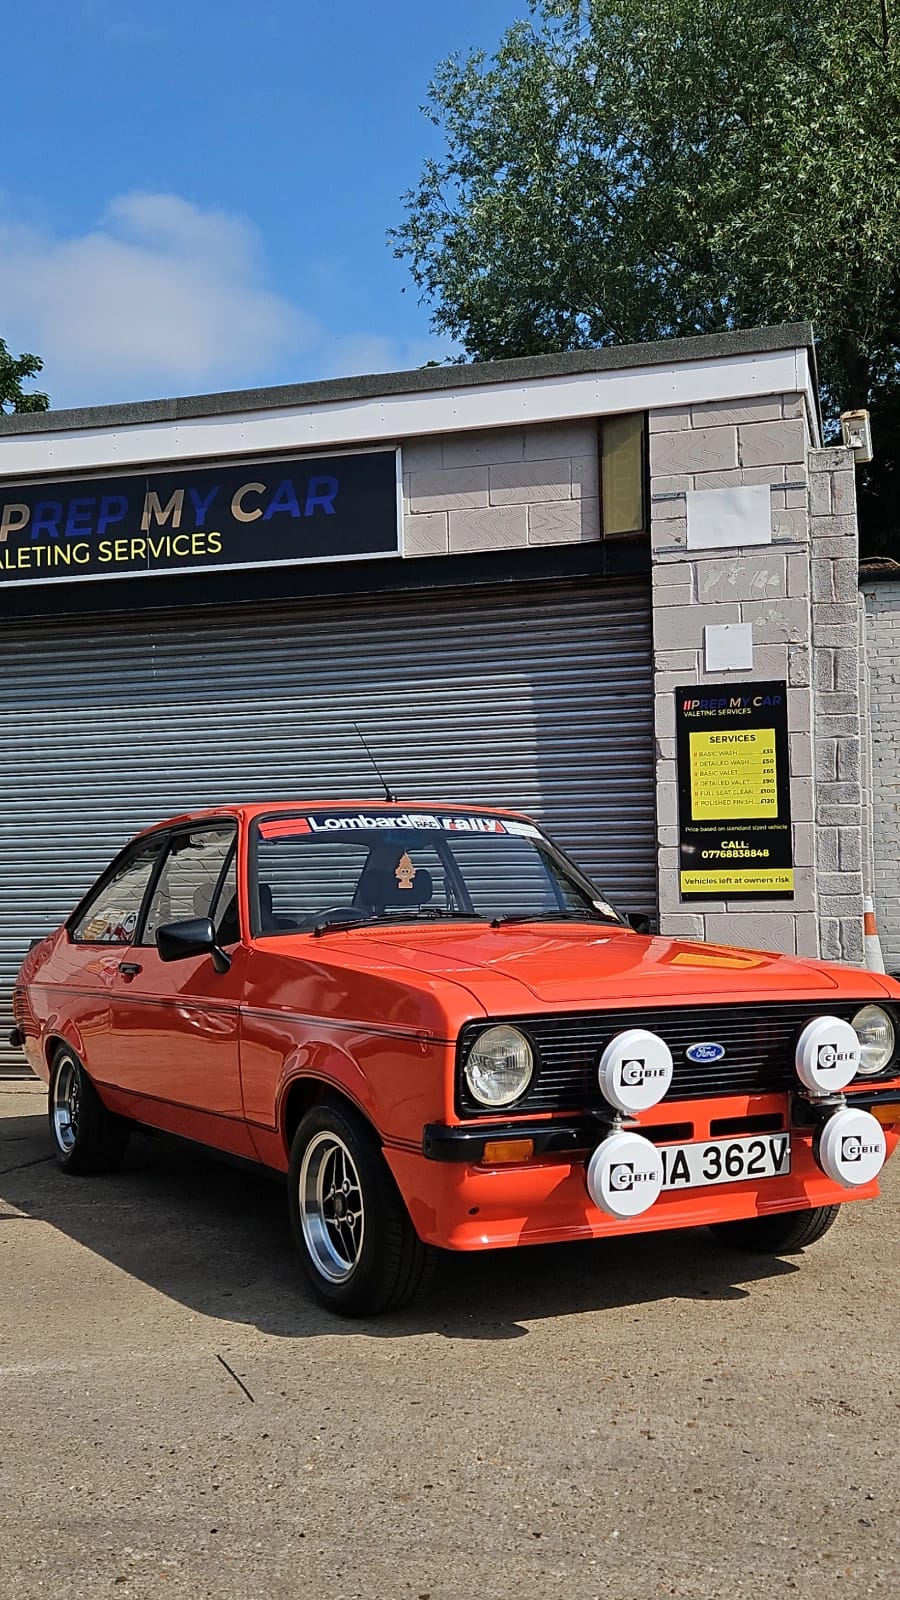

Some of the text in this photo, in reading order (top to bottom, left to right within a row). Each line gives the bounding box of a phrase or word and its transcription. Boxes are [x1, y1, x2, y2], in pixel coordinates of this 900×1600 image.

[0, 476, 339, 542] PREP MY CAR
[98, 532, 223, 563] SERVICES
[730, 696, 750, 708] MY
[753, 695, 781, 707] CAR
[683, 707, 752, 717] VALETING SERVICES
[709, 734, 756, 744] SERVICES
[307, 815, 413, 832] Lombard
[441, 817, 497, 832] rally
[721, 840, 750, 849] CALL:
[825, 1052, 855, 1061] CIBIE
[630, 1070, 666, 1078] CIBIE
[849, 1145, 880, 1154] CIBIE
[702, 1137, 788, 1180] 362V
[619, 1172, 656, 1182] CIBIE
